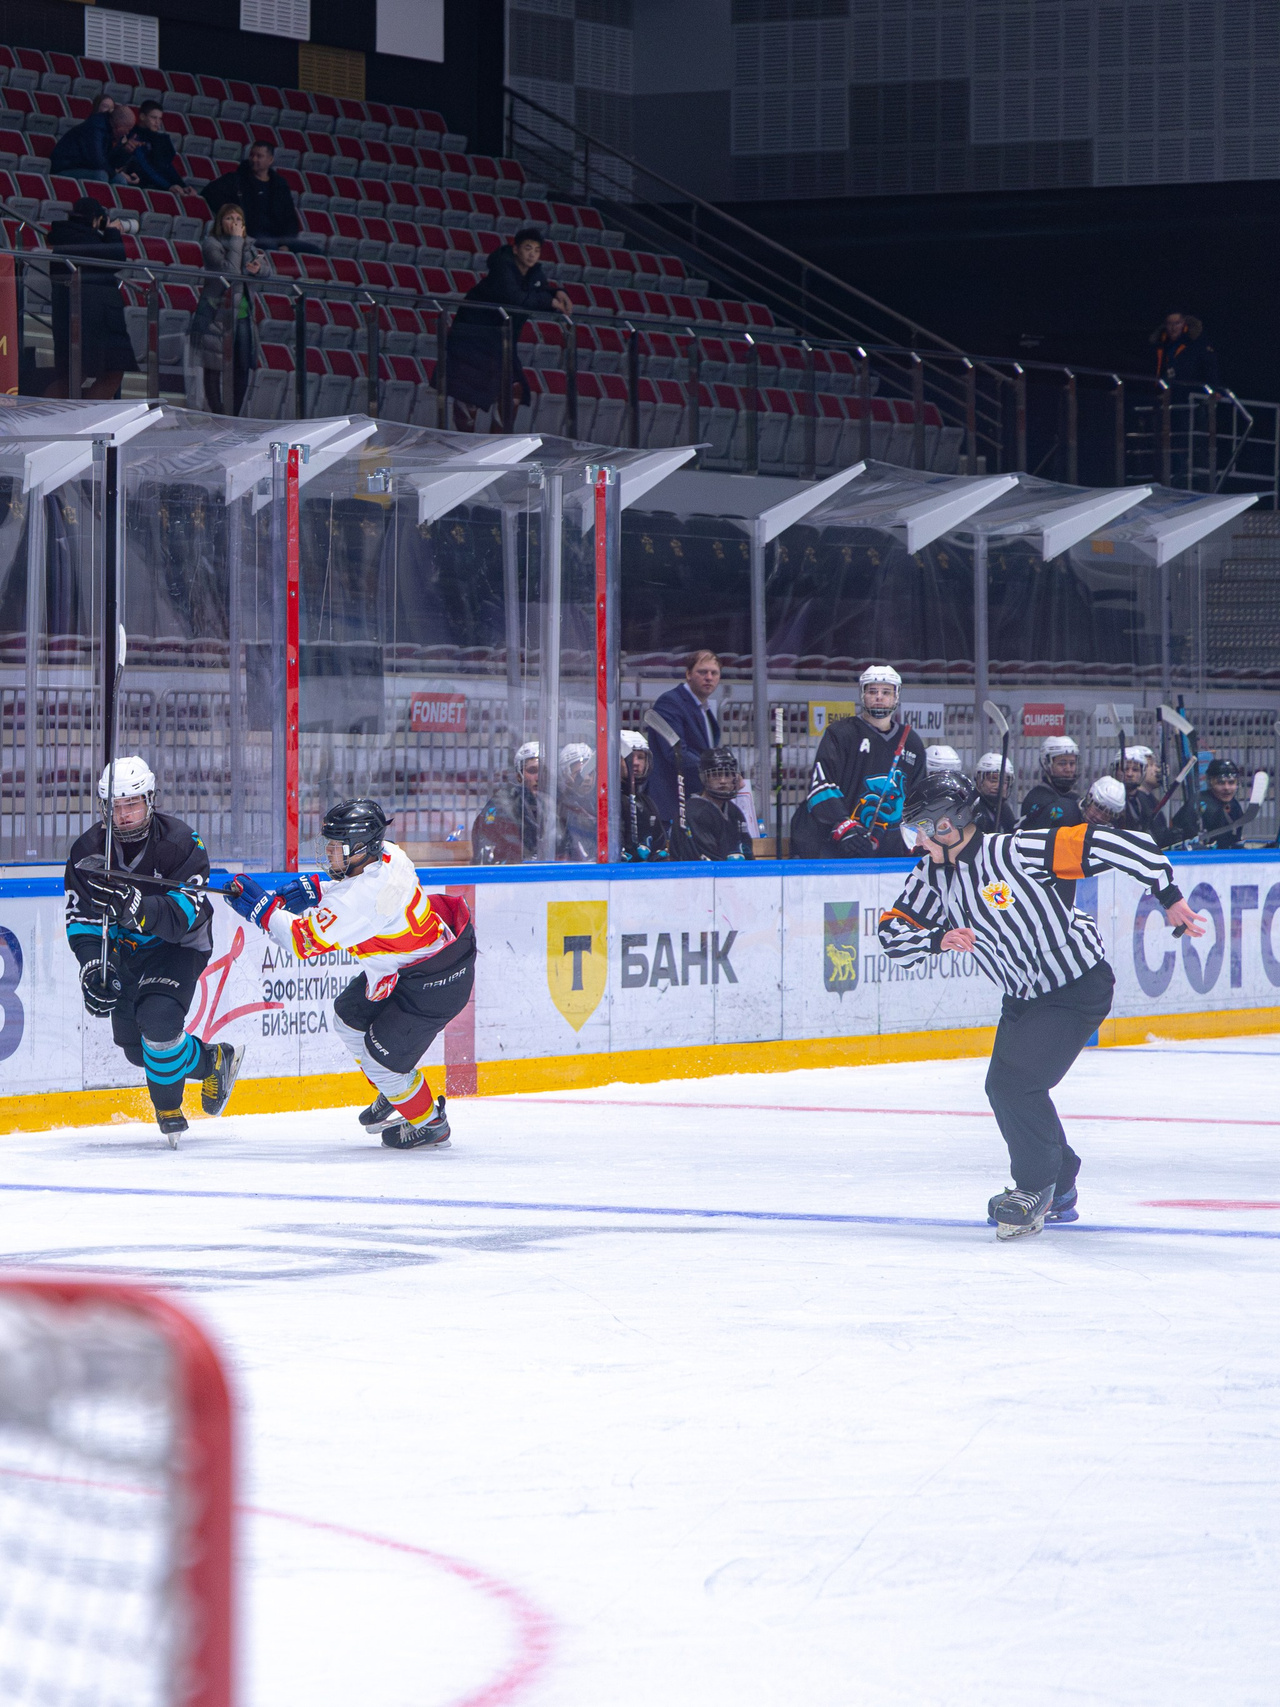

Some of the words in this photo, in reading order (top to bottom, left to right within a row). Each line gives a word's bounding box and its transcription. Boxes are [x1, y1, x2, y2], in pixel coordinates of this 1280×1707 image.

[412, 701, 464, 724] FONBET
[903, 711, 942, 730] KHL.RU
[1024, 714, 1065, 726] OLIMPBET
[860, 738, 870, 753] A
[262, 946, 293, 973] ДЛЯ
[621, 930, 739, 989] БАНК
